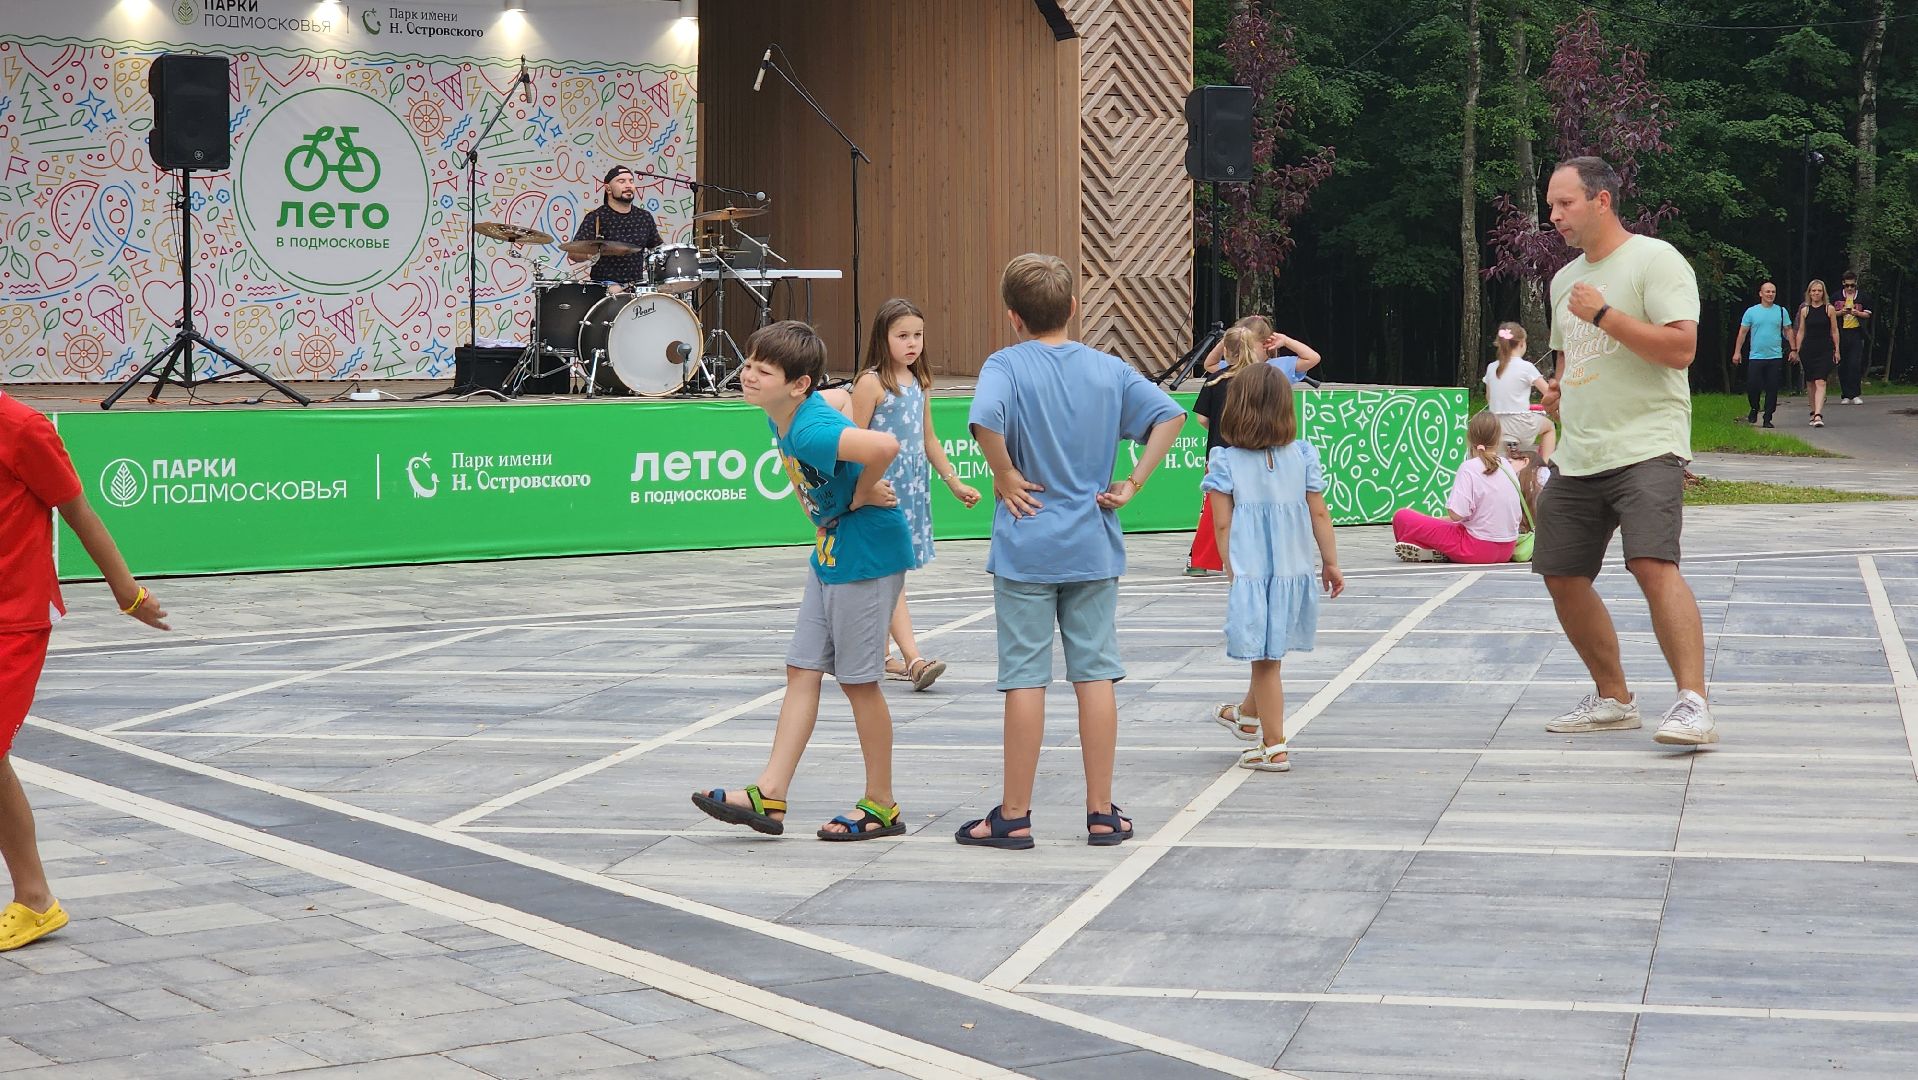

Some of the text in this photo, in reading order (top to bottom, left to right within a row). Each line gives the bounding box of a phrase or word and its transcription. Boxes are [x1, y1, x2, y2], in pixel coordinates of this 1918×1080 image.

[204, 14, 331, 33] ПОДМОСКОВЬЯ
[389, 8, 458, 22] Парк имени
[389, 22, 484, 38] Н. Островского
[276, 201, 390, 230] лето
[290, 237, 390, 251] ПОДМОСКОВЬЕ
[631, 302, 657, 321] Pearl
[941, 439, 981, 457] АРК
[1171, 436, 1199, 451] арк
[152, 457, 236, 479] ПАРКИ
[451, 452, 553, 471] Парк имени
[630, 449, 747, 482] лето
[1165, 453, 1181, 469] Н.
[451, 470, 592, 494] Н. Островского
[153, 479, 348, 505] ПОДМОСКОВЬЯ
[644, 488, 747, 505] ПОДМОСКОВЬЕ
